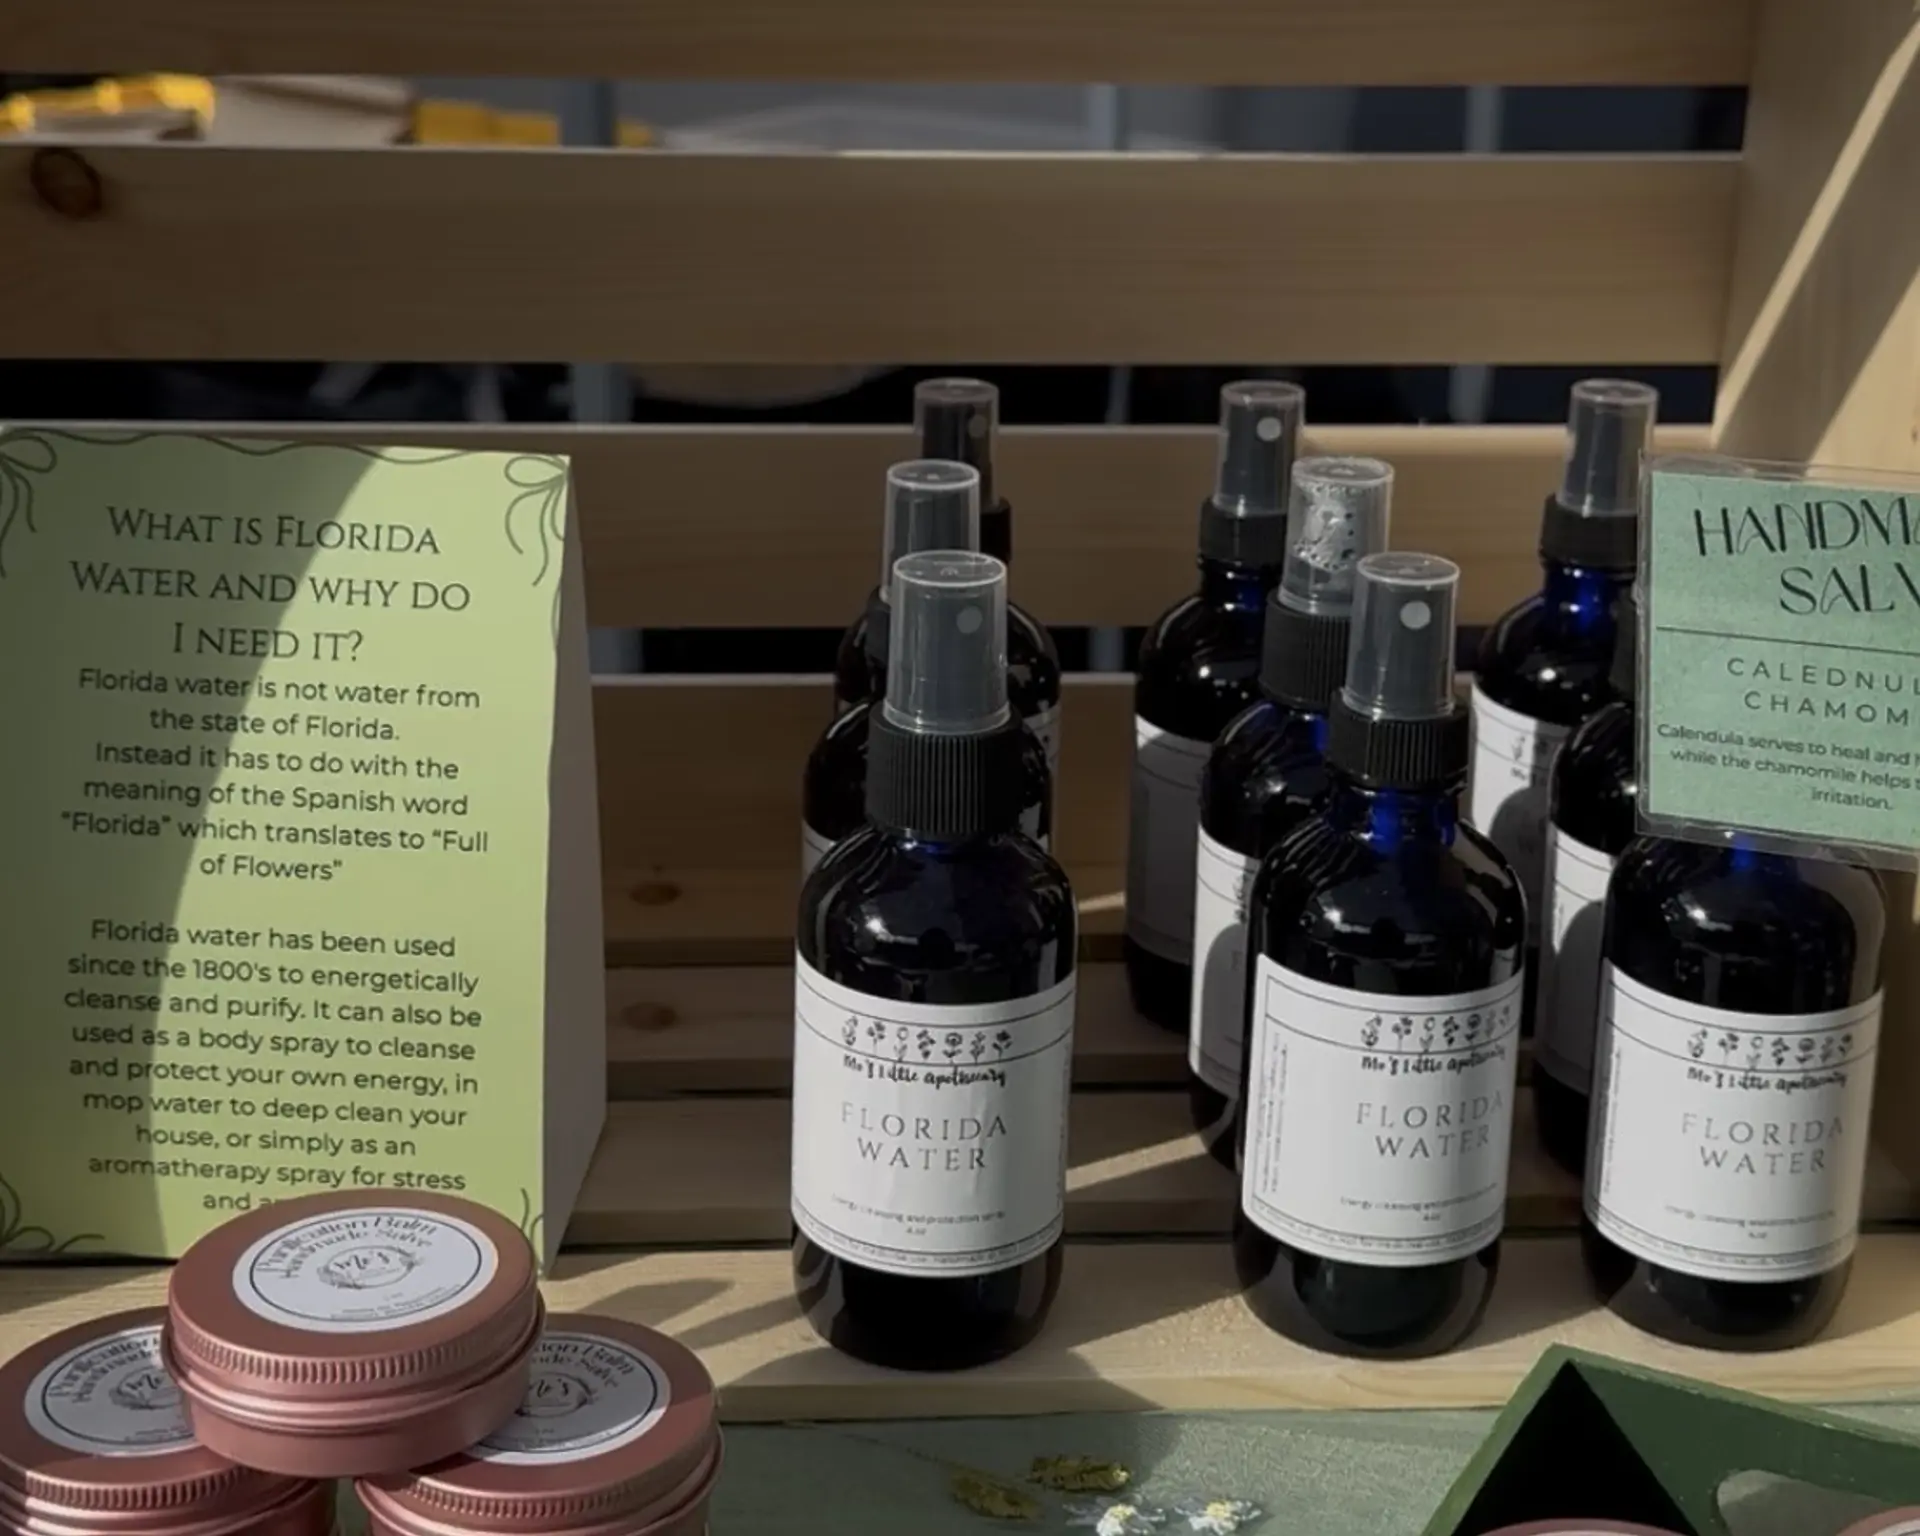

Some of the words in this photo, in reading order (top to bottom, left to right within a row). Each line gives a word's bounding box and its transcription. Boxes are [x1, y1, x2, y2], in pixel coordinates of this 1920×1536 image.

[107, 506, 223, 542] WHAT
[234, 517, 262, 546] IS
[276, 515, 440, 554] FLORIDA
[1694, 494, 1920, 557] HANDM
[69, 561, 199, 597] WATER
[209, 574, 296, 602] AND
[309, 577, 399, 607] WHY
[412, 582, 470, 611] DO
[174, 622, 183, 653] I
[196, 627, 299, 658] NEED
[313, 630, 363, 661] IT?
[79, 668, 168, 693] Florida
[175, 677, 250, 697] water
[258, 676, 276, 698] is
[285, 682, 327, 701] not
[335, 685, 409, 704] water
[416, 684, 479, 708] from
[150, 708, 194, 730] the
[201, 713, 265, 734] state
[272, 713, 299, 735] of
[306, 715, 399, 740] Florida.
[97, 742, 191, 766] Instead
[200, 746, 217, 768] it
[225, 748, 269, 770] has
[276, 753, 302, 771] to
[310, 752, 343, 773] do
[351, 754, 407, 776] with
[416, 757, 458, 779] the
[1657, 724, 1744, 746] Calendula
[1748, 736, 1804, 753] serves
[1808, 743, 1827, 756] to
[1831, 744, 1870, 762] heal
[1874, 751, 1911, 766] and
[1670, 749, 1717, 765] while
[1722, 750, 1751, 769] the
[1755, 759, 1857, 783] chamomile
[1861, 770, 1911, 790] helps
[84, 780, 201, 807] meaning
[209, 783, 235, 804] of
[241, 785, 285, 807] the
[293, 787, 394, 812] Spanish
[402, 795, 467, 815] word
[1812, 787, 1893, 810] irritation.
[178, 818, 256, 840] which
[265, 824, 392, 848] translates
[398, 830, 425, 849] to
[200, 854, 227, 875] of
[233, 855, 342, 881] Flowers"
[92, 919, 179, 943] Florida
[187, 928, 261, 947] water
[269, 928, 314, 950] has
[321, 931, 385, 953] been
[394, 937, 455, 957] used
[68, 953, 135, 976] since
[142, 957, 186, 978] the
[192, 959, 271, 982] 1800's
[278, 966, 304, 984] to
[311, 969, 479, 997] energetically
[64, 988, 161, 1011] cleanse
[169, 994, 218, 1014] and
[227, 997, 306, 1022] purify.
[314, 1000, 331, 1020] It
[337, 1005, 383, 1021] can
[392, 1004, 442, 1025] also
[450, 1006, 481, 1027] be
[73, 1024, 133, 1044] used
[142, 1029, 169, 1045] as
[177, 1031, 190, 1047] a
[199, 1028, 264, 1055] body
[270, 1036, 339, 1058] spray
[346, 1037, 372, 1056] to
[378, 1037, 476, 1060] cleanse
[70, 1057, 119, 1077] and
[127, 1062, 221, 1081] protect
[227, 1067, 284, 1087] your
[292, 1071, 346, 1086] own
[354, 1074, 447, 1097] energy,
[456, 1073, 478, 1094] in
[83, 1093, 144, 1114] mop
[149, 1097, 223, 1114] water
[229, 1098, 256, 1116] to
[263, 1098, 329, 1123] deep
[335, 1102, 402, 1122] clean
[410, 1109, 467, 1129] your
[841, 1100, 1007, 1142] FLORIDA
[1357, 1090, 1504, 1130] FLORIDA
[136, 1124, 219, 1149] house,
[226, 1133, 252, 1147] or
[259, 1130, 344, 1157] simply
[351, 1139, 378, 1154] as
[385, 1140, 415, 1155] an
[1375, 1124, 1489, 1159] WATER
[1681, 1112, 1844, 1145] FLORIDA
[857, 1136, 986, 1172] WATER
[1699, 1145, 1826, 1175] WATER
[89, 1158, 270, 1185] aromatherapy
[277, 1167, 345, 1188] spray
[352, 1165, 385, 1186] for
[393, 1171, 466, 1190] stress
[203, 1193, 251, 1210] and
